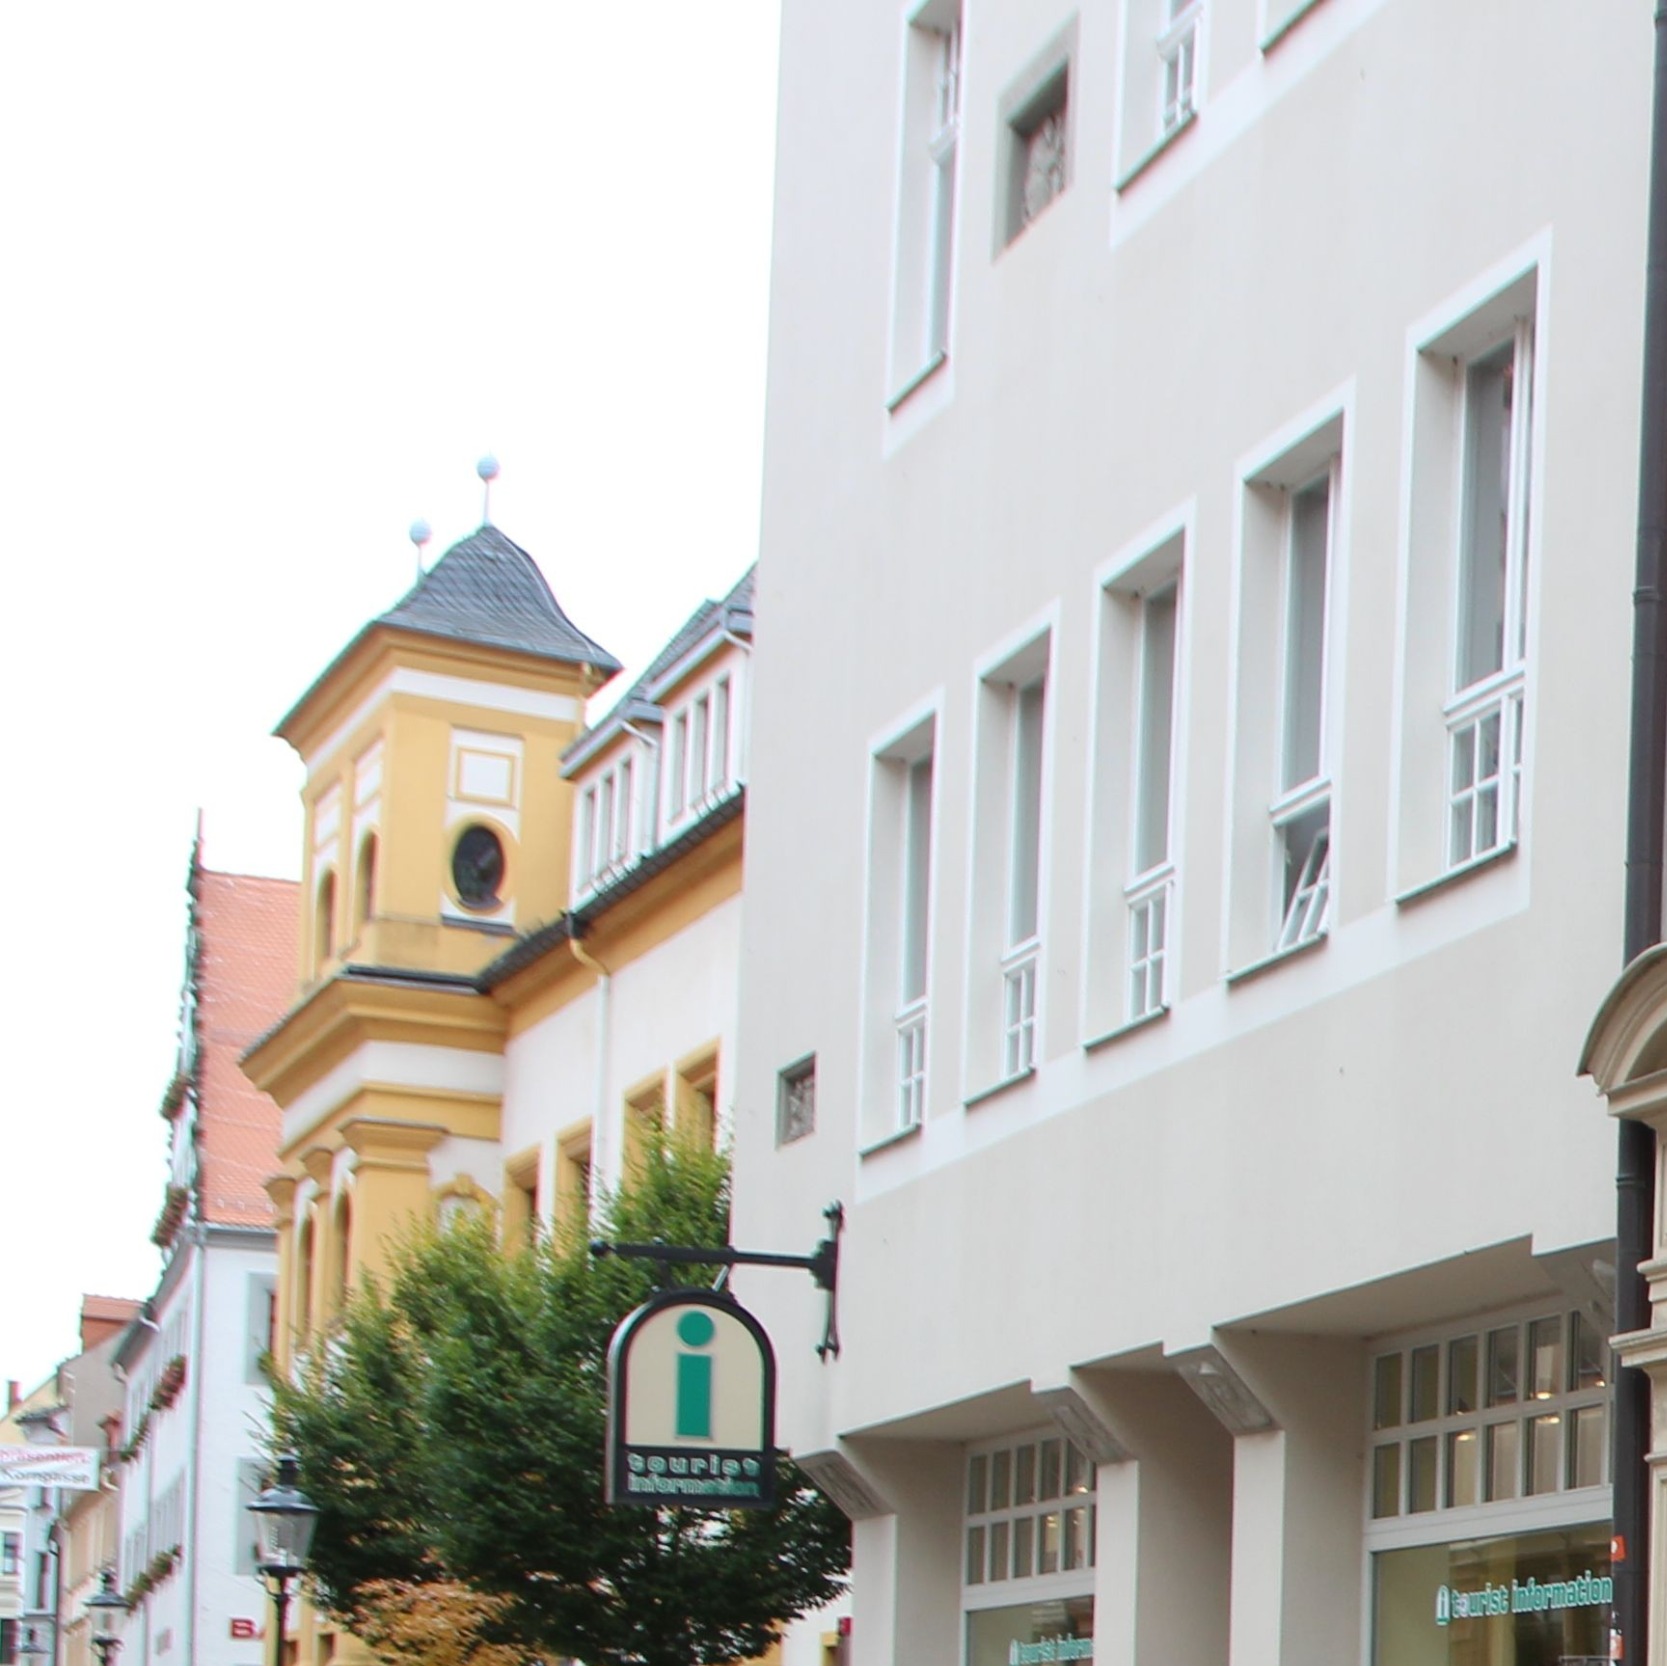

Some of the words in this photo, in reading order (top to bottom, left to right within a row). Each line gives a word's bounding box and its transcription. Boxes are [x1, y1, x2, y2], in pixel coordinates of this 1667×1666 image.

[627, 1453, 761, 1476] tourist
[627, 1473, 761, 1497] information
[1451, 1582, 1509, 1618] tourist
[1511, 1569, 1613, 1614] information
[1020, 1635, 1056, 1665] tourist
